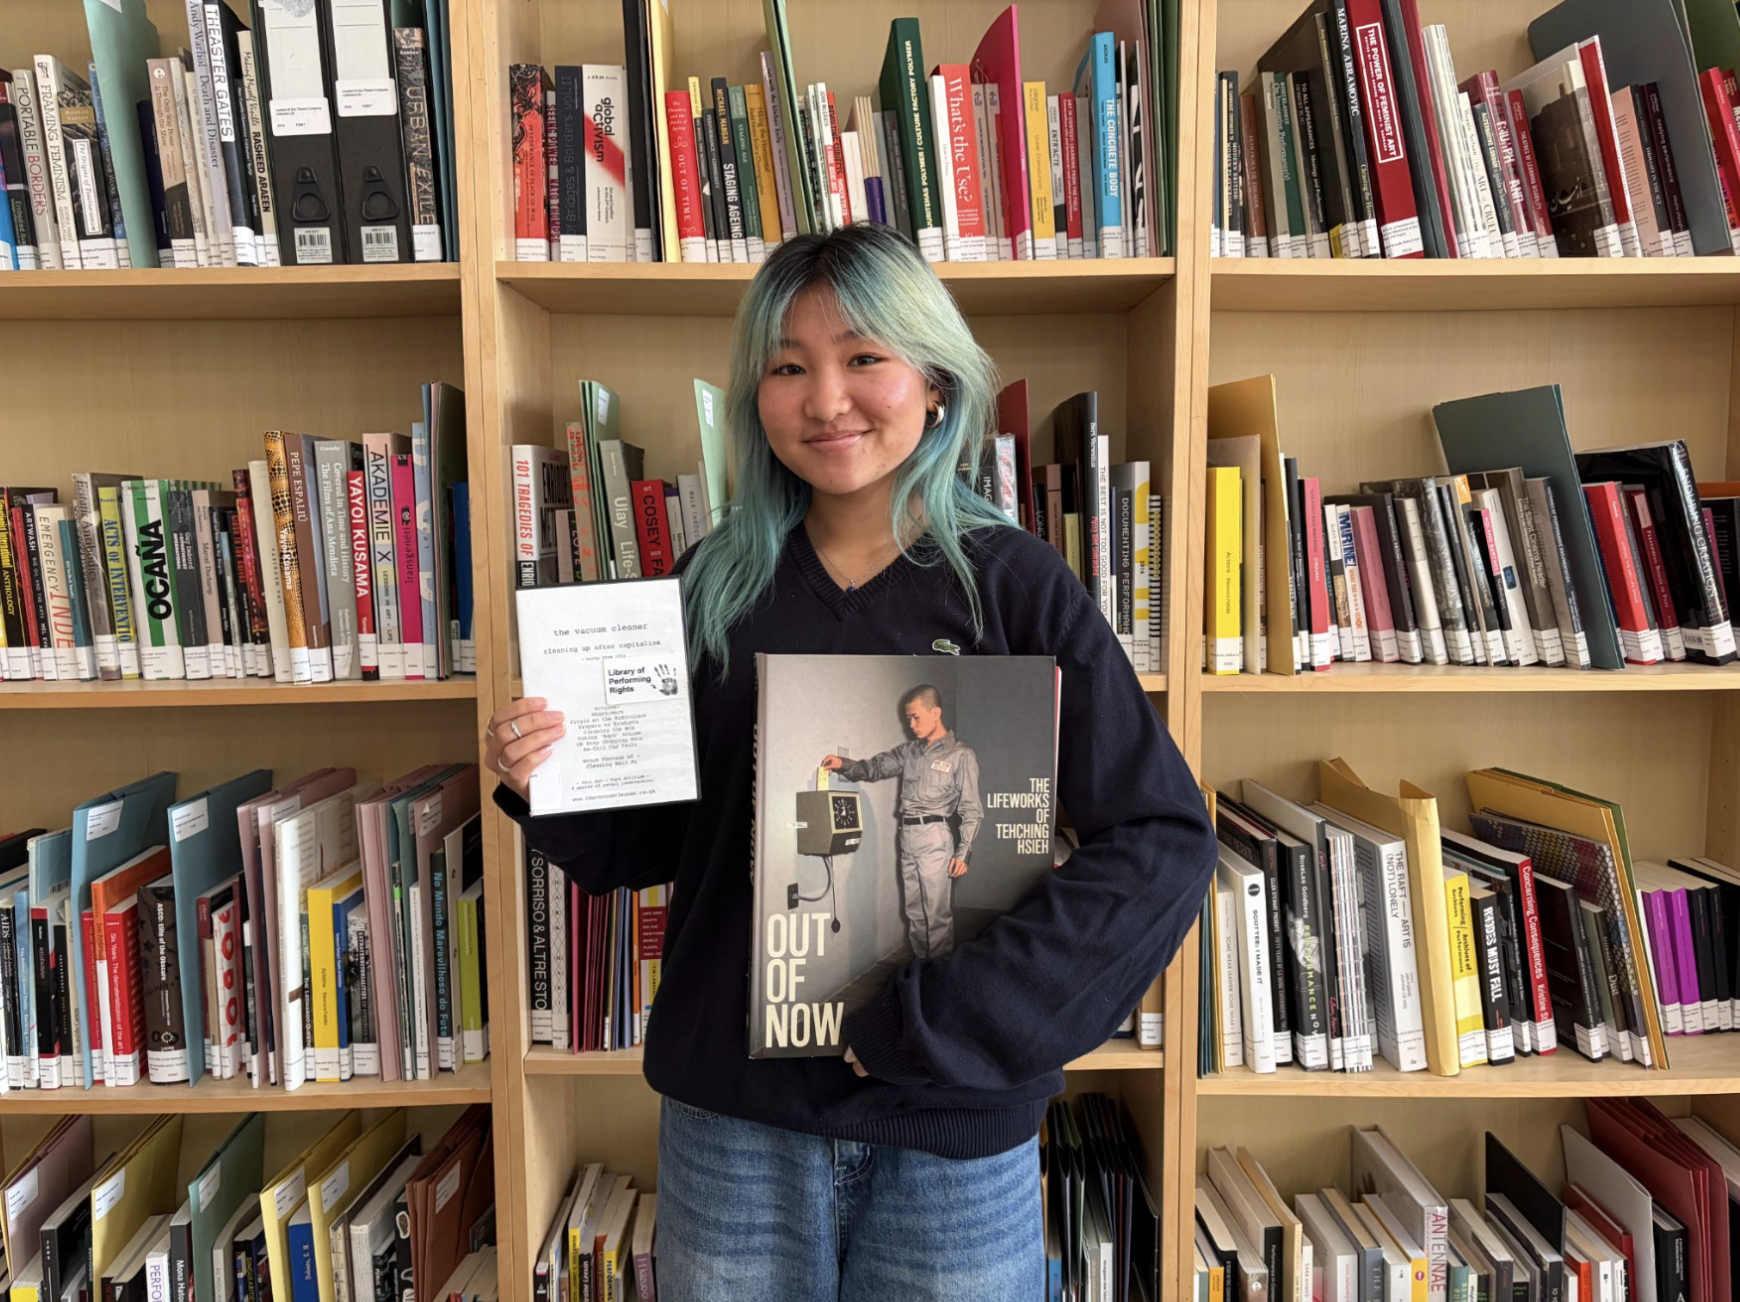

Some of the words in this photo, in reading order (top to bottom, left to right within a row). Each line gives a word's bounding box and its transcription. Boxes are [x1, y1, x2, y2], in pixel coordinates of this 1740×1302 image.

[189, 0, 200, 29] Andy
[1337, 8, 1349, 51] MARINA
[195, 30, 207, 68] Warhol
[206, 9, 226, 84] THEASTER
[1368, 28, 1377, 45] THE
[905, 41, 914, 76] POLYMER
[1372, 48, 1382, 80] POWER
[199, 75, 209, 102] Death
[717, 88, 725, 115] MICHAEL
[909, 77, 919, 111] FACTORY
[1378, 83, 1385, 92] OF
[17, 87, 38, 151] PORTABLE
[215, 90, 233, 137] GATES
[407, 86, 427, 157] URBAN
[601, 97, 615, 135] global
[949, 78, 965, 135] What's
[1106, 98, 1116, 116] THE
[1380, 95, 1393, 136] FEMINIST
[41, 84, 59, 141] FRAMING
[50, 144, 67, 201] FEMINISM
[207, 119, 219, 169] Disaster
[913, 112, 923, 146] CULTURE
[1107, 120, 1117, 170] CONCRETE
[253, 131, 267, 173] RASHEED
[762, 138, 770, 172] Horizontal
[954, 138, 969, 161] the
[1388, 138, 1396, 156] ART
[724, 164, 738, 202] STAGING
[917, 151, 929, 187] POLYMER
[957, 165, 973, 202] Use?
[1109, 172, 1118, 197] BODY
[27, 155, 45, 217] BORDERS
[258, 175, 271, 213] ARAEEN
[415, 168, 435, 224] EXILE
[682, 179, 688, 197] OF
[682, 197, 691, 221] TIME
[729, 205, 742, 239] AGEING
[291, 452, 301, 477] PEPE
[321, 464, 329, 480] The
[333, 462, 342, 497] Covered
[516, 460, 529, 478] 101
[294, 479, 308, 522] ESPALIÚ
[323, 482, 332, 505] Films
[337, 499, 343, 507] in
[349, 476, 364, 524] YAYOI
[370, 451, 390, 541] AKADEMIE
[1683, 468, 1701, 530] ENDURING
[325, 506, 332, 519] of
[337, 508, 345, 527] Time
[518, 484, 532, 539] TRAGEDIES
[614, 497, 628, 529] Ulay
[644, 495, 660, 546] COSEY
[1100, 508, 1106, 519] IS
[25, 513, 35, 551] ARTWASH
[104, 519, 119, 546] ACTS
[280, 528, 289, 552] Yayoi
[1122, 497, 1130, 568] DOCUMENTING
[40, 516, 59, 591] EMERGENCY
[109, 552, 120, 562] OF
[202, 543, 211, 566] Marcel
[328, 537, 338, 577] Mendieta
[341, 546, 350, 583] History
[353, 528, 369, 598] KUSAMA
[377, 551, 391, 562] X
[521, 544, 533, 556] OF
[1488, 541, 1499, 574] BARTHES
[1529, 530, 1539, 559] Cinema
[1535, 560, 1547, 589] Reader
[135, 519, 173, 620] OCAÑA
[282, 553, 292, 590] Kusama
[575, 627, 607, 635] vacuum
[611, 623, 648, 632] cleaner
[544, 646, 578, 655] cleaning
[619, 640, 661, 649] capitalism
[608, 668, 635, 677] Library
[609, 676, 651, 684] Performing
[987, 793, 1049, 808] LIFEWORKS
[1029, 778, 1049, 793] THE
[995, 824, 1049, 839] TEHCHING
[1036, 808, 1049, 823] OF
[1017, 839, 1049, 854] HSIEH
[1395, 850, 1404, 868] THE
[433, 872, 442, 888] No
[1300, 854, 1308, 880] RoseLee
[1386, 854, 1396, 886] (NOT)
[531, 857, 545, 922] SORRISO
[1398, 870, 1406, 898] RAFT
[435, 891, 443, 926] Mundo
[1389, 888, 1399, 919] LONELY
[532, 924, 546, 933] &
[767, 912, 831, 957] OUT
[1401, 919, 1410, 935] ART
[1483, 906, 1496, 945] RHODES
[1522, 866, 1533, 914] Concerning
[1529, 916, 1542, 980] Consequences
[533, 935, 547, 979] ALTRE
[1404, 937, 1411, 948] IS
[1487, 946, 1499, 972] MUST
[437, 929, 446, 996] Maravilhoso
[1304, 924, 1318, 1010] PERFORMANCE
[767, 958, 806, 1003] OF
[1257, 977, 1262, 985] IT
[1490, 975, 1502, 1002] FALL
[440, 998, 446, 1010] do
[766, 1002, 844, 1048] NOW
[1431, 1213, 1446, 1292] ANTENNAE
[176, 1260, 184, 1281] Mona
